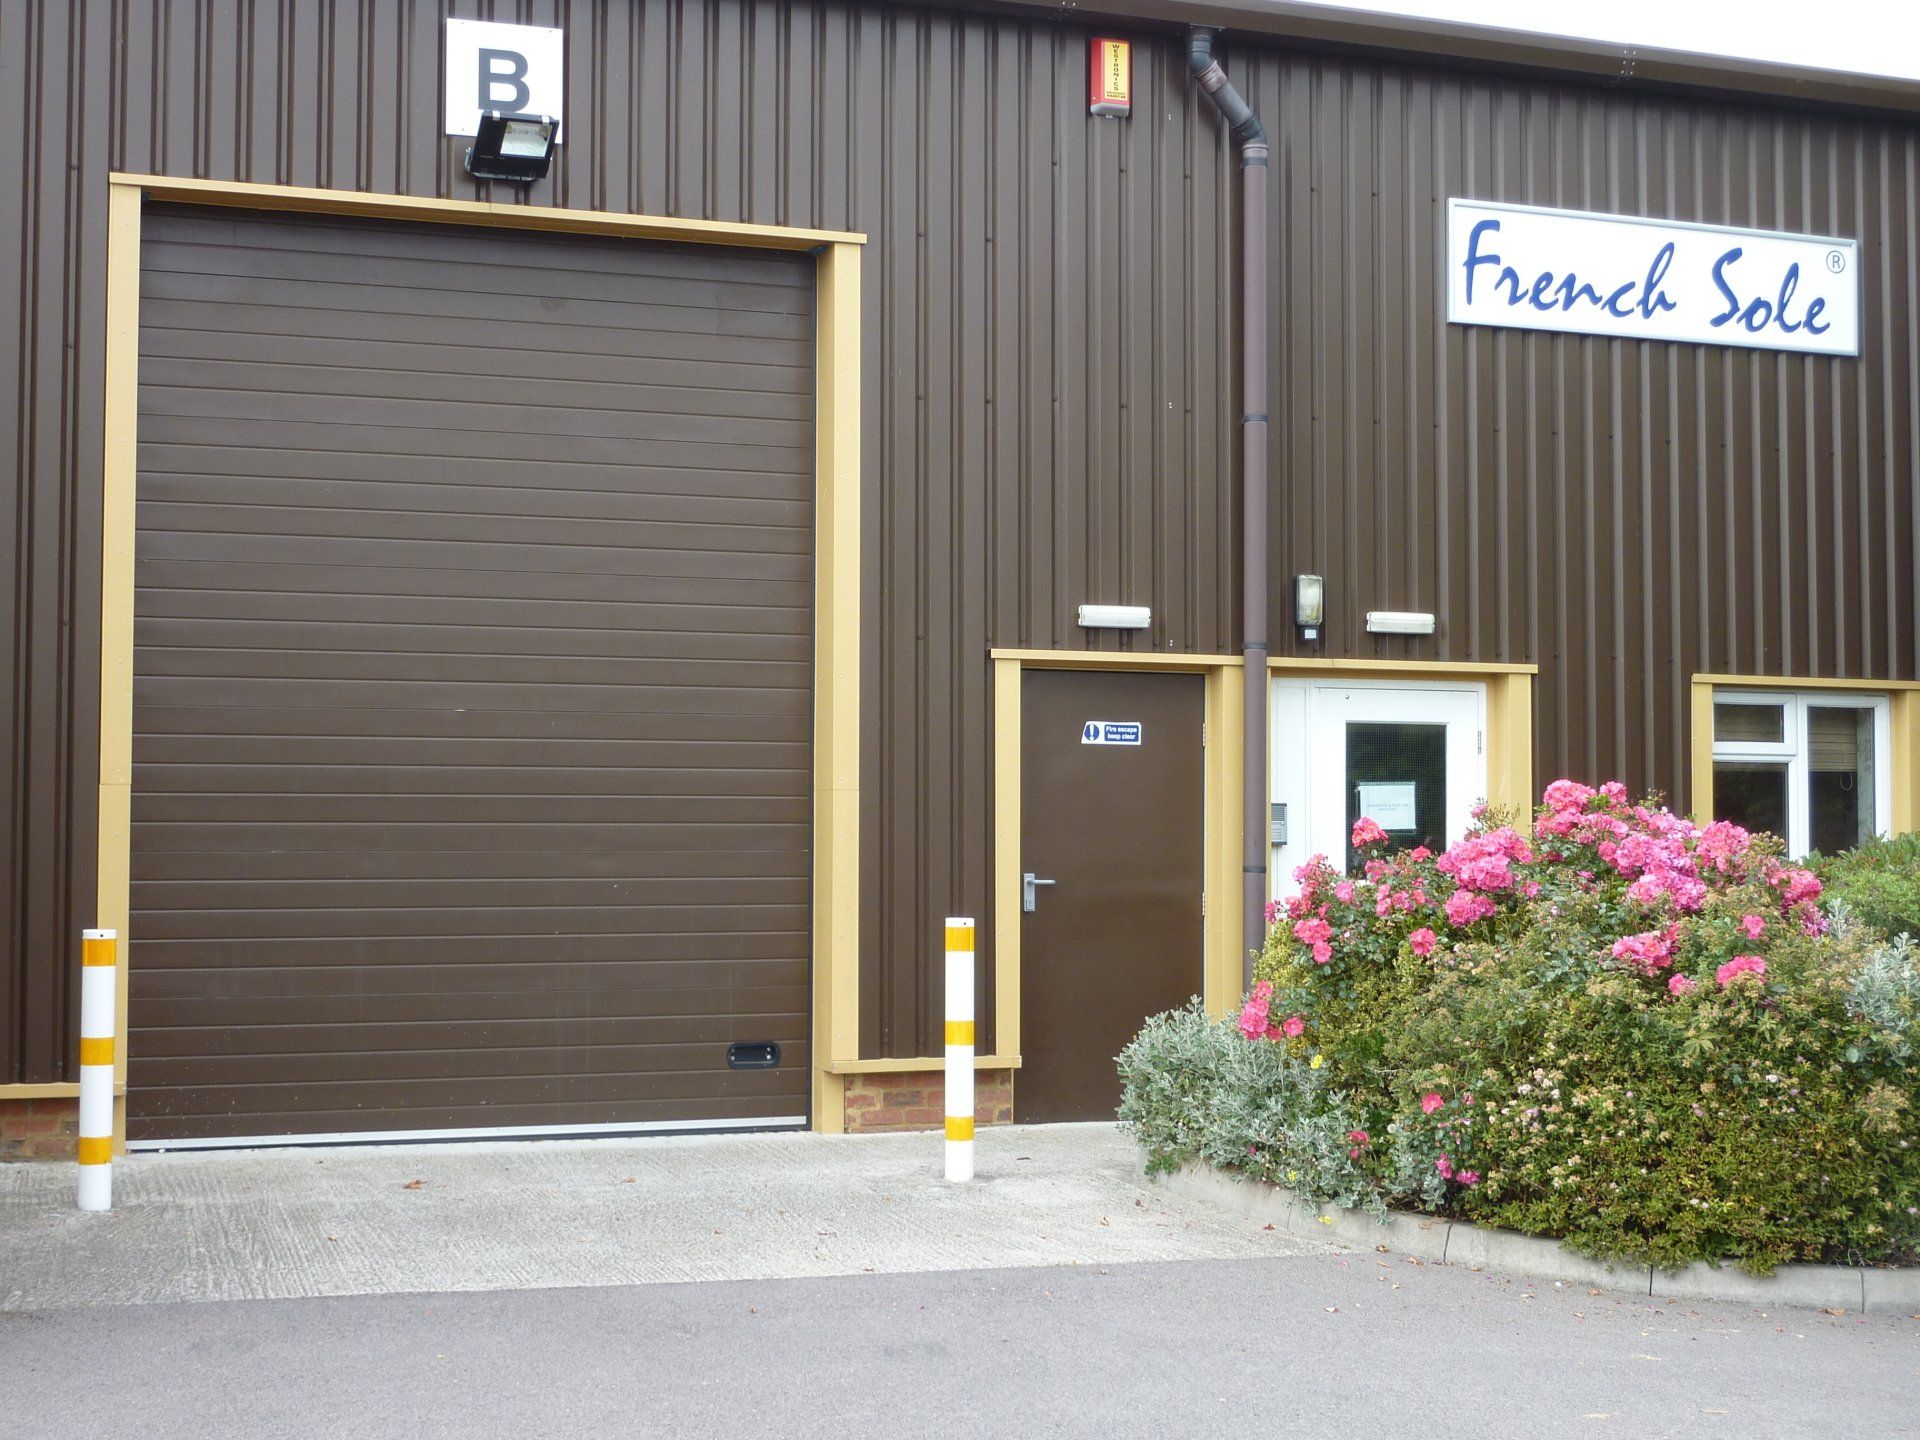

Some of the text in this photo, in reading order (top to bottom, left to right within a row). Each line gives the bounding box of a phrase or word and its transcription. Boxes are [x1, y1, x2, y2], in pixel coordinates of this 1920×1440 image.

[478, 47, 530, 113] B
[1462, 219, 1677, 319] French
[1710, 247, 1831, 335] Sole
[1117, 726, 1138, 734] escape
